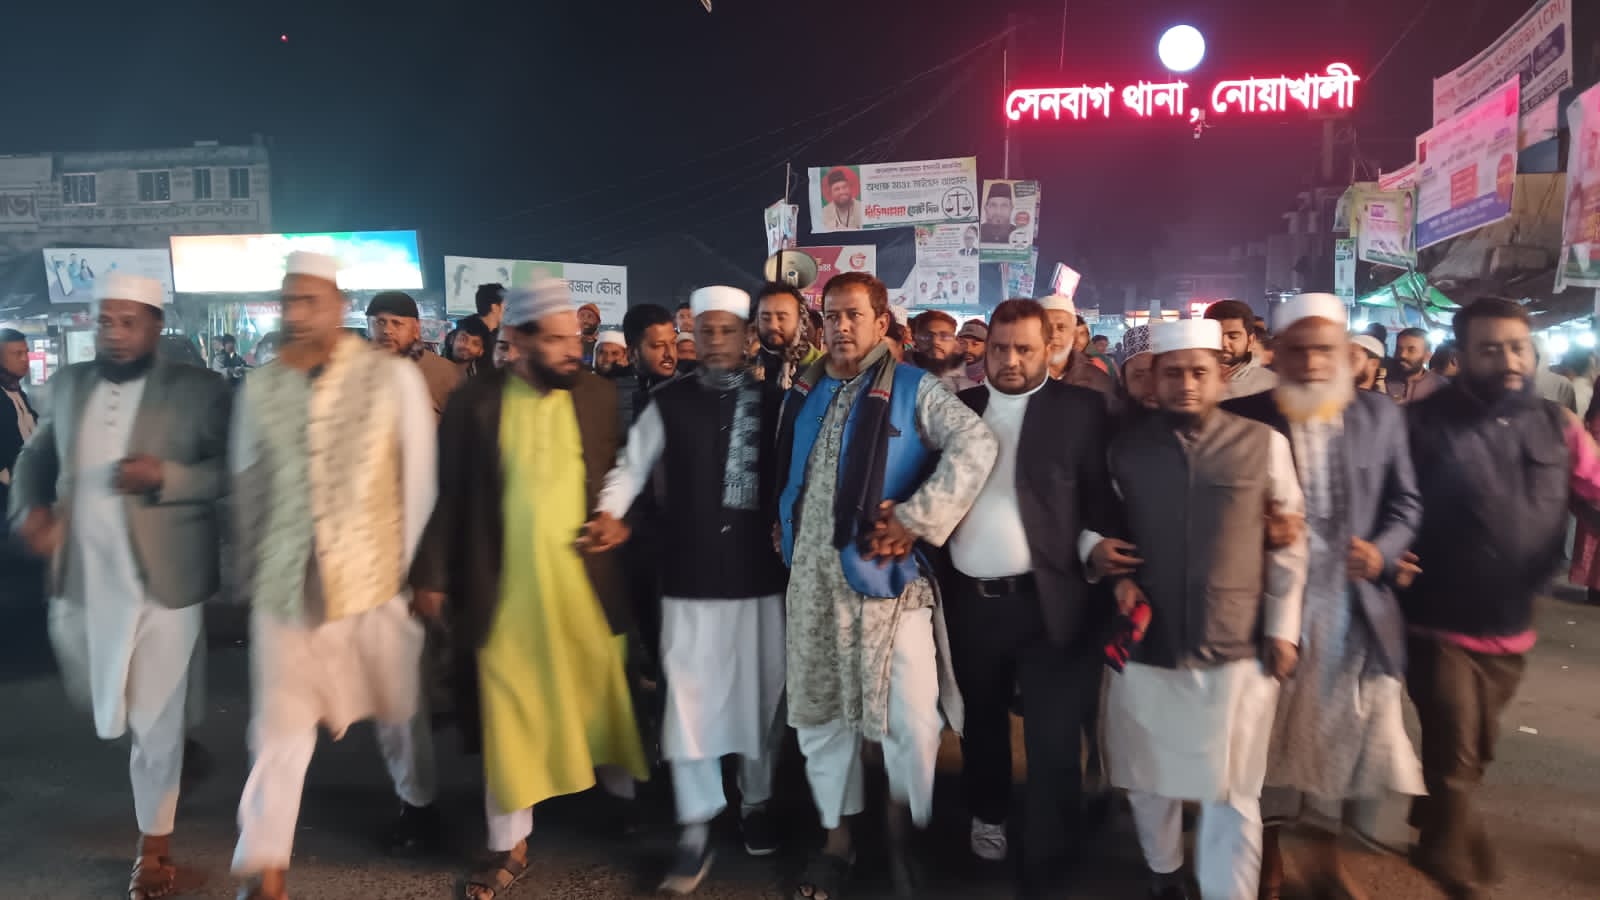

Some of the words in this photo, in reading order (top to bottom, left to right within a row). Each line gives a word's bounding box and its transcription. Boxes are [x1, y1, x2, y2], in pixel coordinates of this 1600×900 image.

[1005, 83, 1115, 122] সেনবাগ
[1121, 79, 1201, 124] থানা,
[1211, 62, 1361, 115] নোয়াখালী
